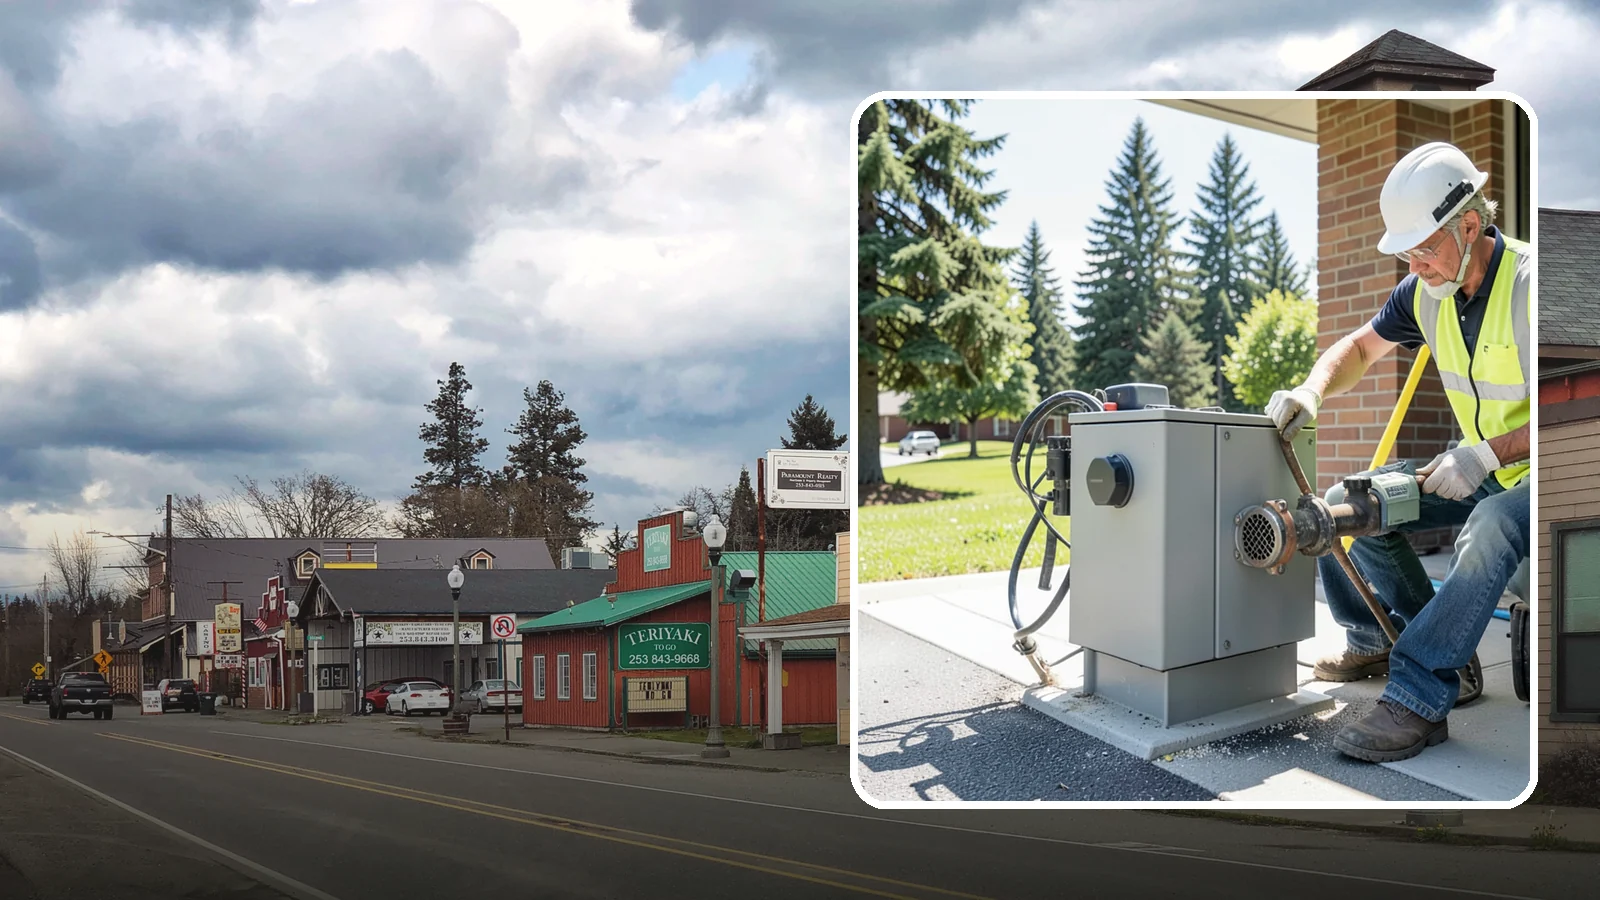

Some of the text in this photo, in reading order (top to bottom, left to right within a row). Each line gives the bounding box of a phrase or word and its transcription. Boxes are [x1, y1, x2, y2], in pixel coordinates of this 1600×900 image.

[781, 471, 838, 480] PARAMOUNT REALTY
[625, 627, 702, 646] TERIYAKI
[628, 654, 700, 664] 253 843-9668
[639, 681, 672, 691] TERIYAKI
